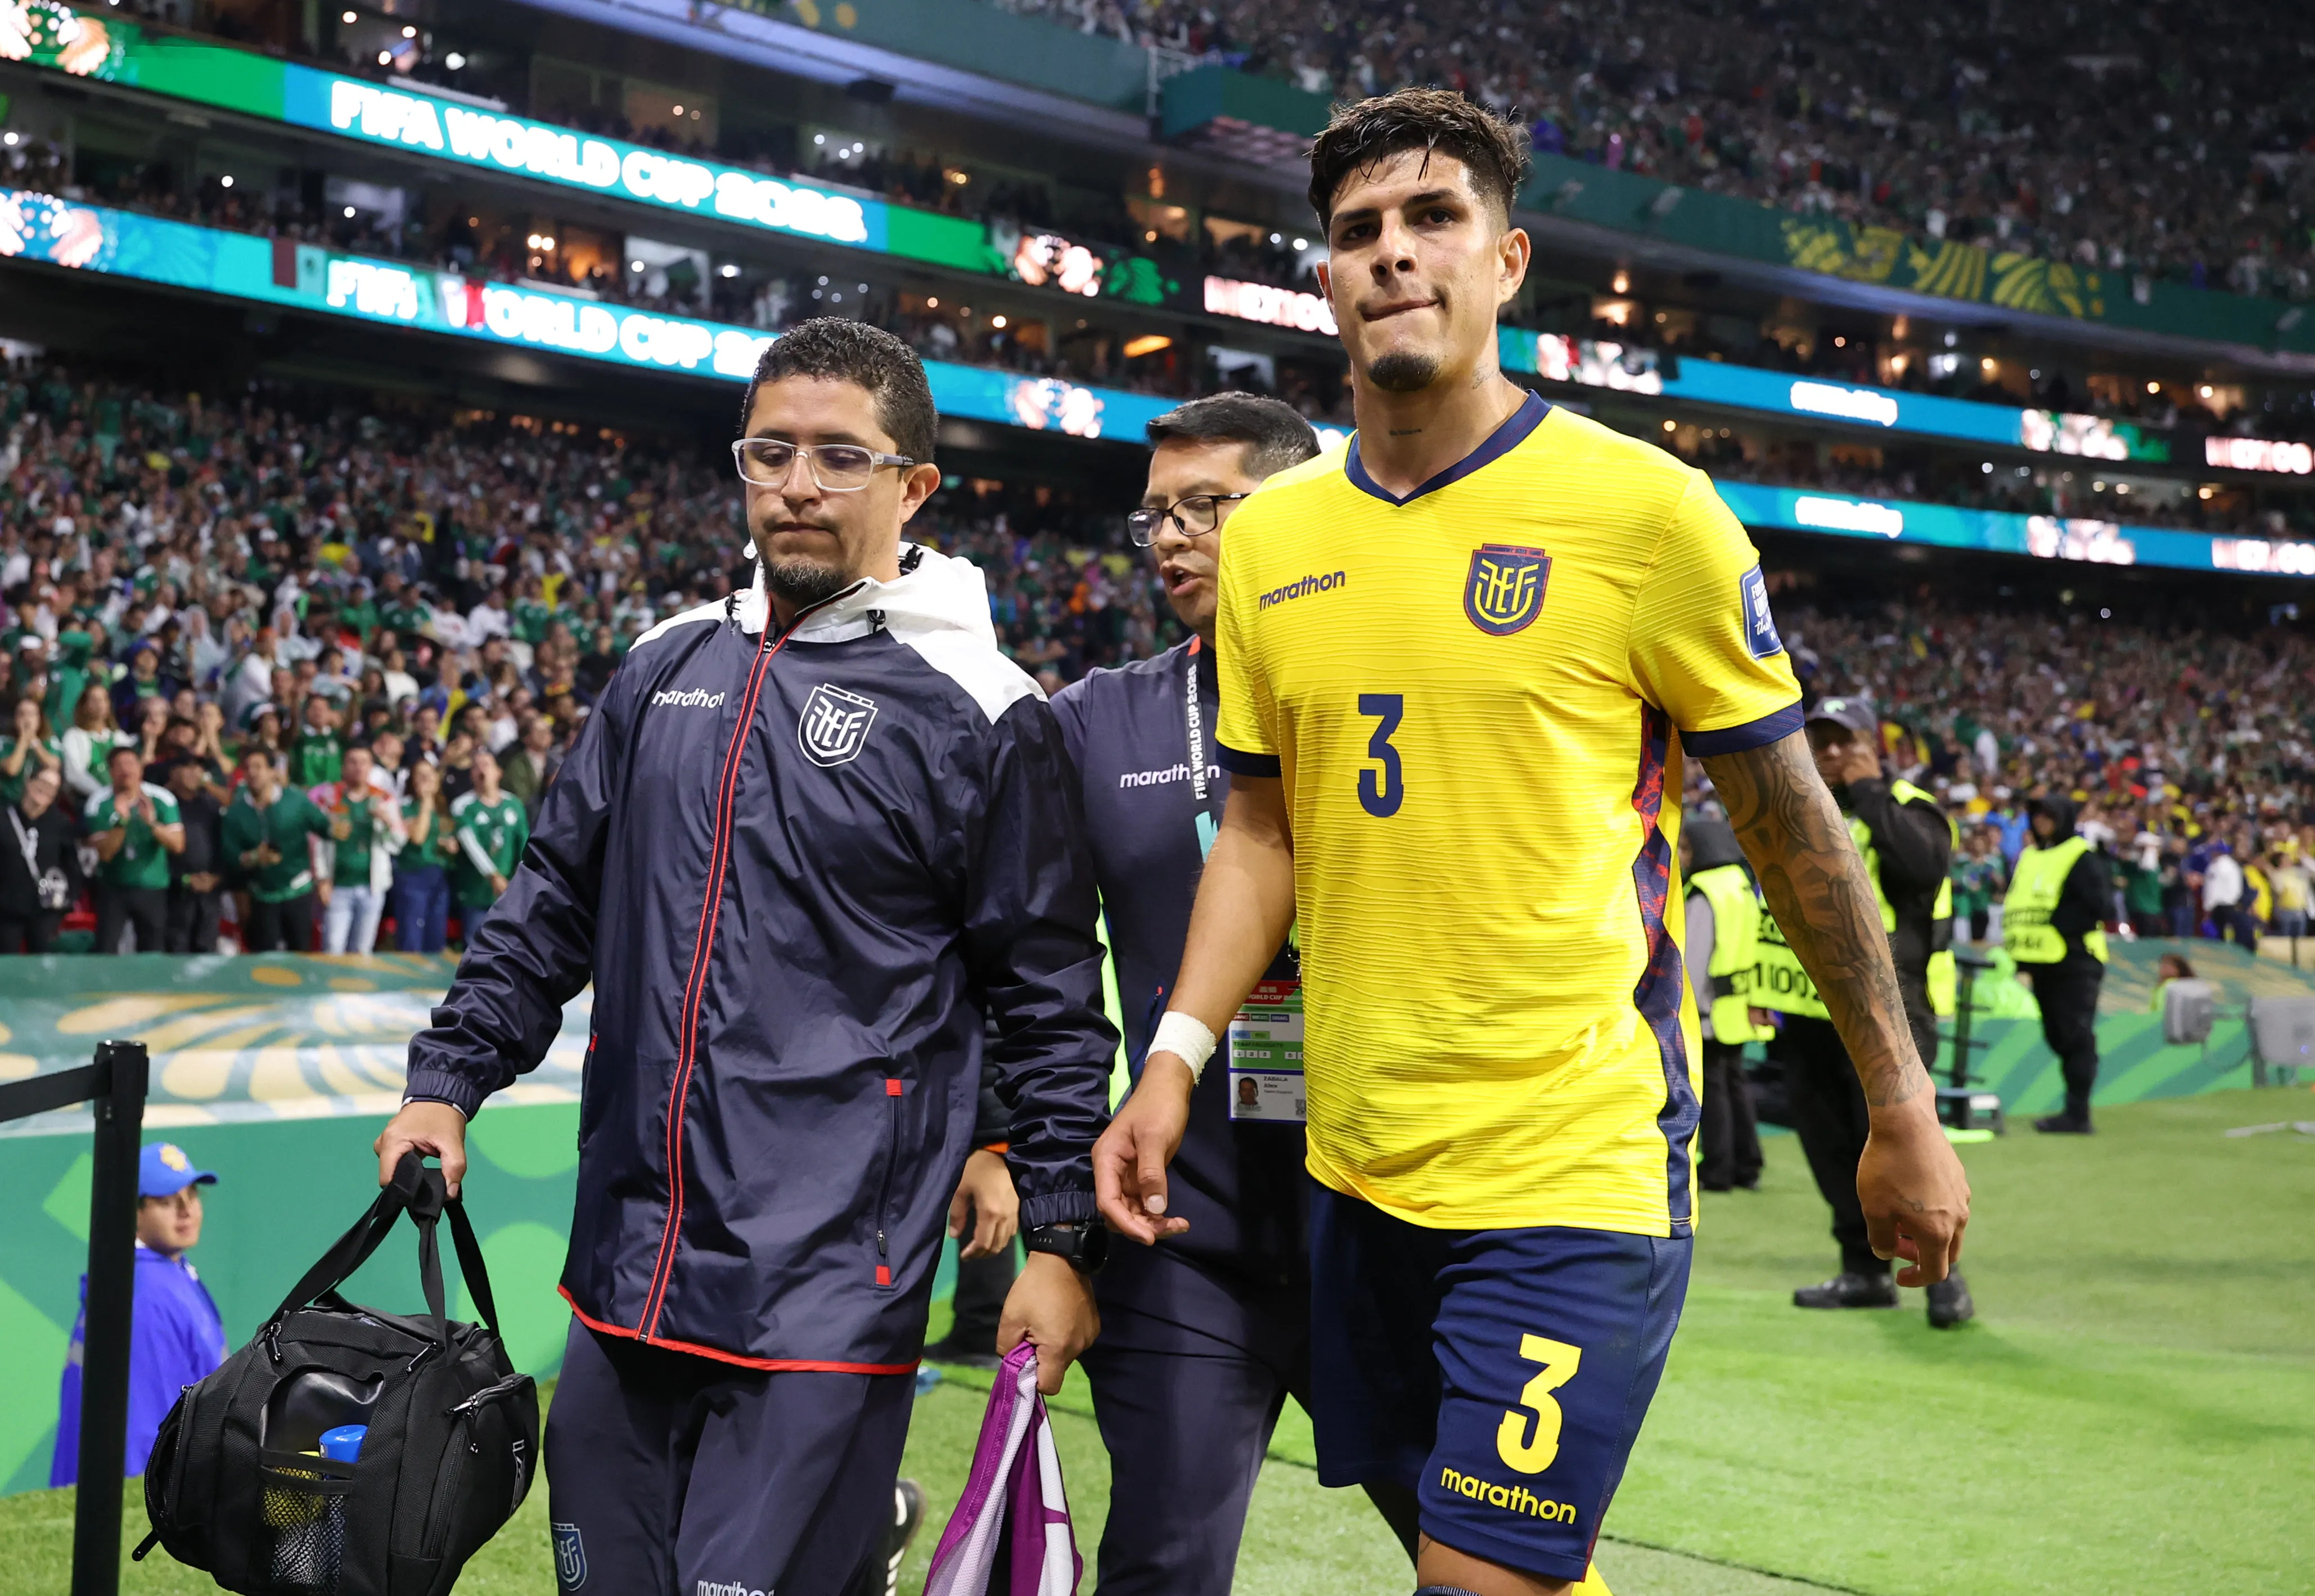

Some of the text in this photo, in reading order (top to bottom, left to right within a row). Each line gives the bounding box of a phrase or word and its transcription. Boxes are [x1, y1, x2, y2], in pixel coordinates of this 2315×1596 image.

[331, 80, 444, 150] FIFA
[444, 107, 620, 187] WORLD
[621, 151, 715, 208] CUP
[619, 314, 713, 368] CUP
[1259, 570, 1345, 611] marathon
[1188, 704, 1200, 728] CUP
[1189, 728, 1204, 772] WORLD
[1357, 694, 1404, 818] 3
[1120, 763, 1220, 788] marathn
[1193, 772, 1207, 800] FIFA
[1497, 1333, 1582, 1475] 3
[1440, 1467, 1577, 1526] marathon
